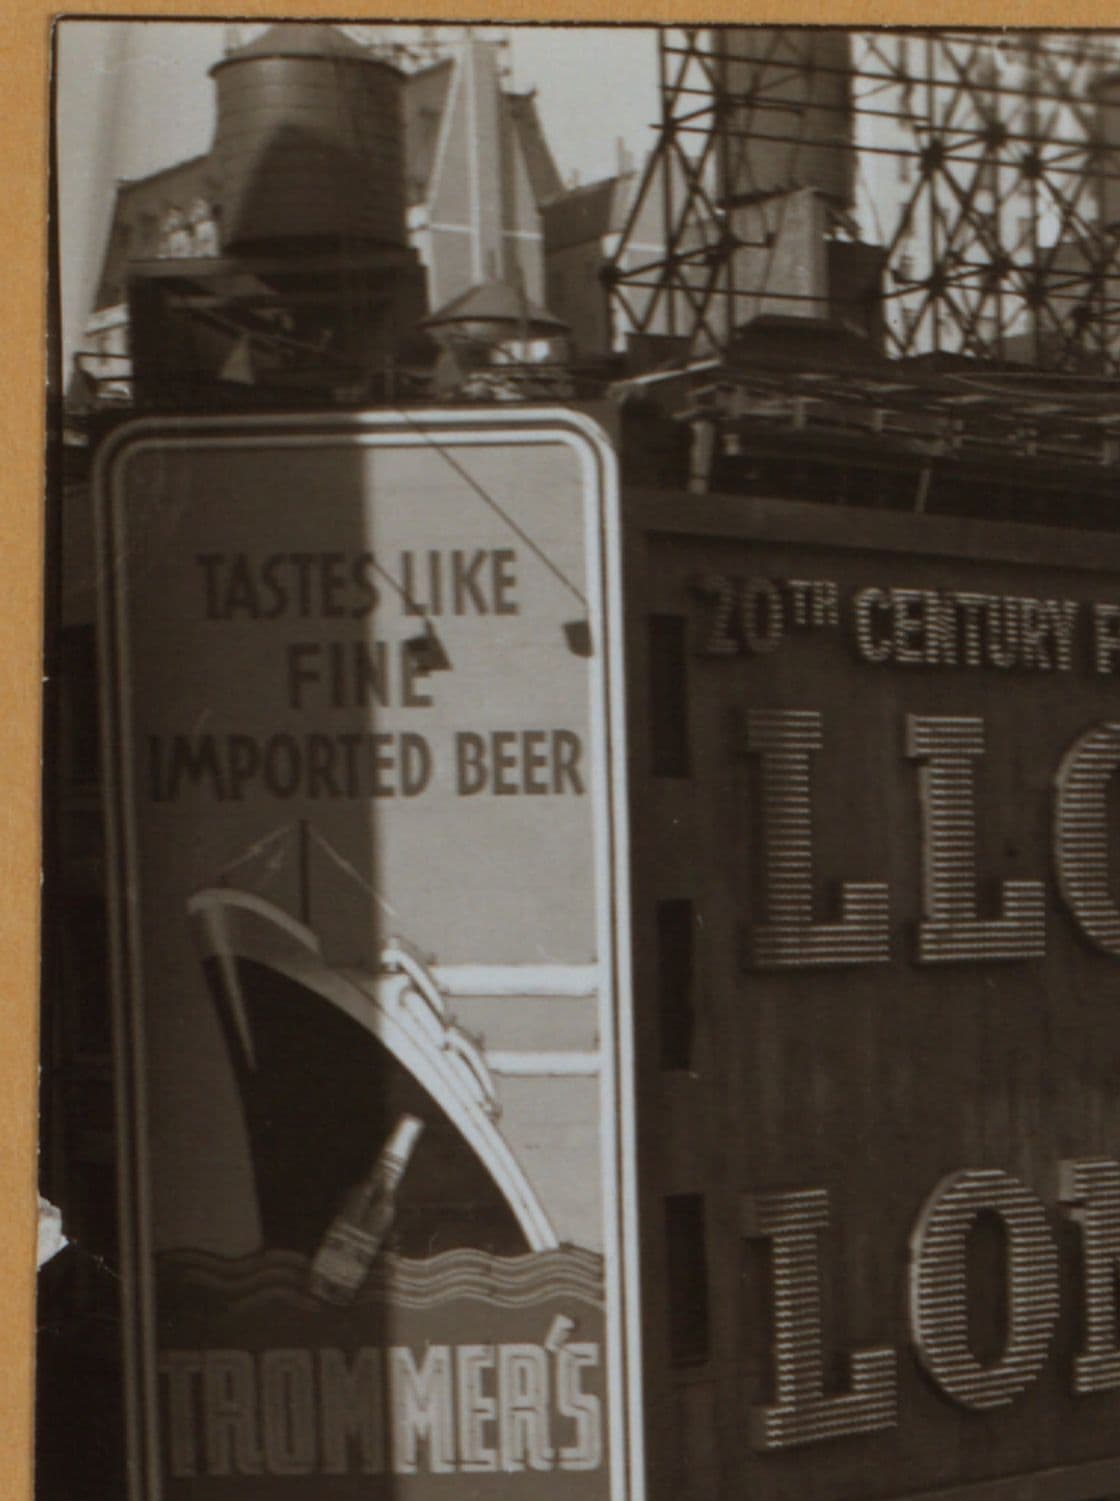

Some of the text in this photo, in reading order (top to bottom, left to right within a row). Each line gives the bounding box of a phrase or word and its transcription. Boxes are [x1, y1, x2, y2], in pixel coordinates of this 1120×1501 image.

[195, 548, 519, 620] TASTES LIKE
[852, 585, 1081, 673] CENTURY
[286, 640, 434, 709] FINE
[145, 728, 588, 801] IMPORTED BEER
[157, 1315, 606, 1477] TROMMER'S
